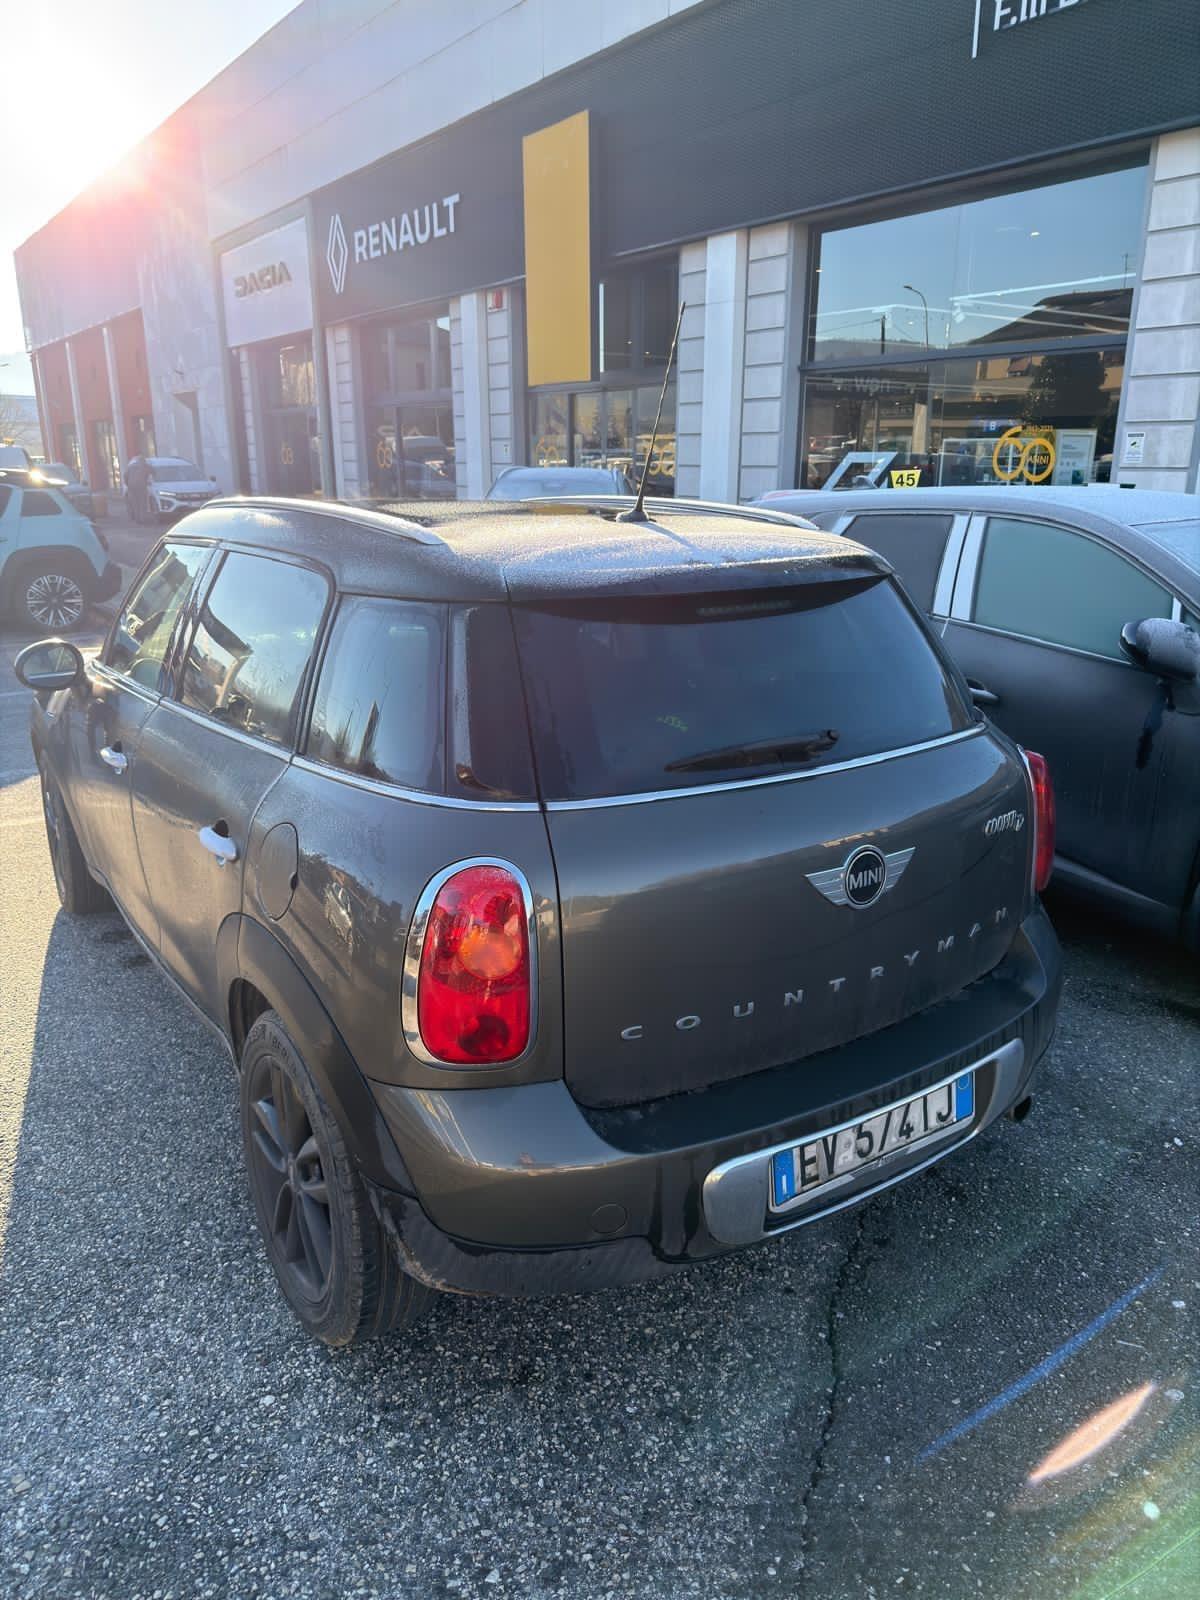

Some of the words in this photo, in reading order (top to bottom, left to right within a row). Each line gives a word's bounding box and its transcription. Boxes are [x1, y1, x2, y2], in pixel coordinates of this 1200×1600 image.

[353, 193, 461, 264] RENAULT
[1026, 454, 1049, 466] ANNI
[895, 473, 916, 487] 45
[848, 866, 884, 892] MINI
[620, 906, 1009, 1041] COUNTRYMAN
